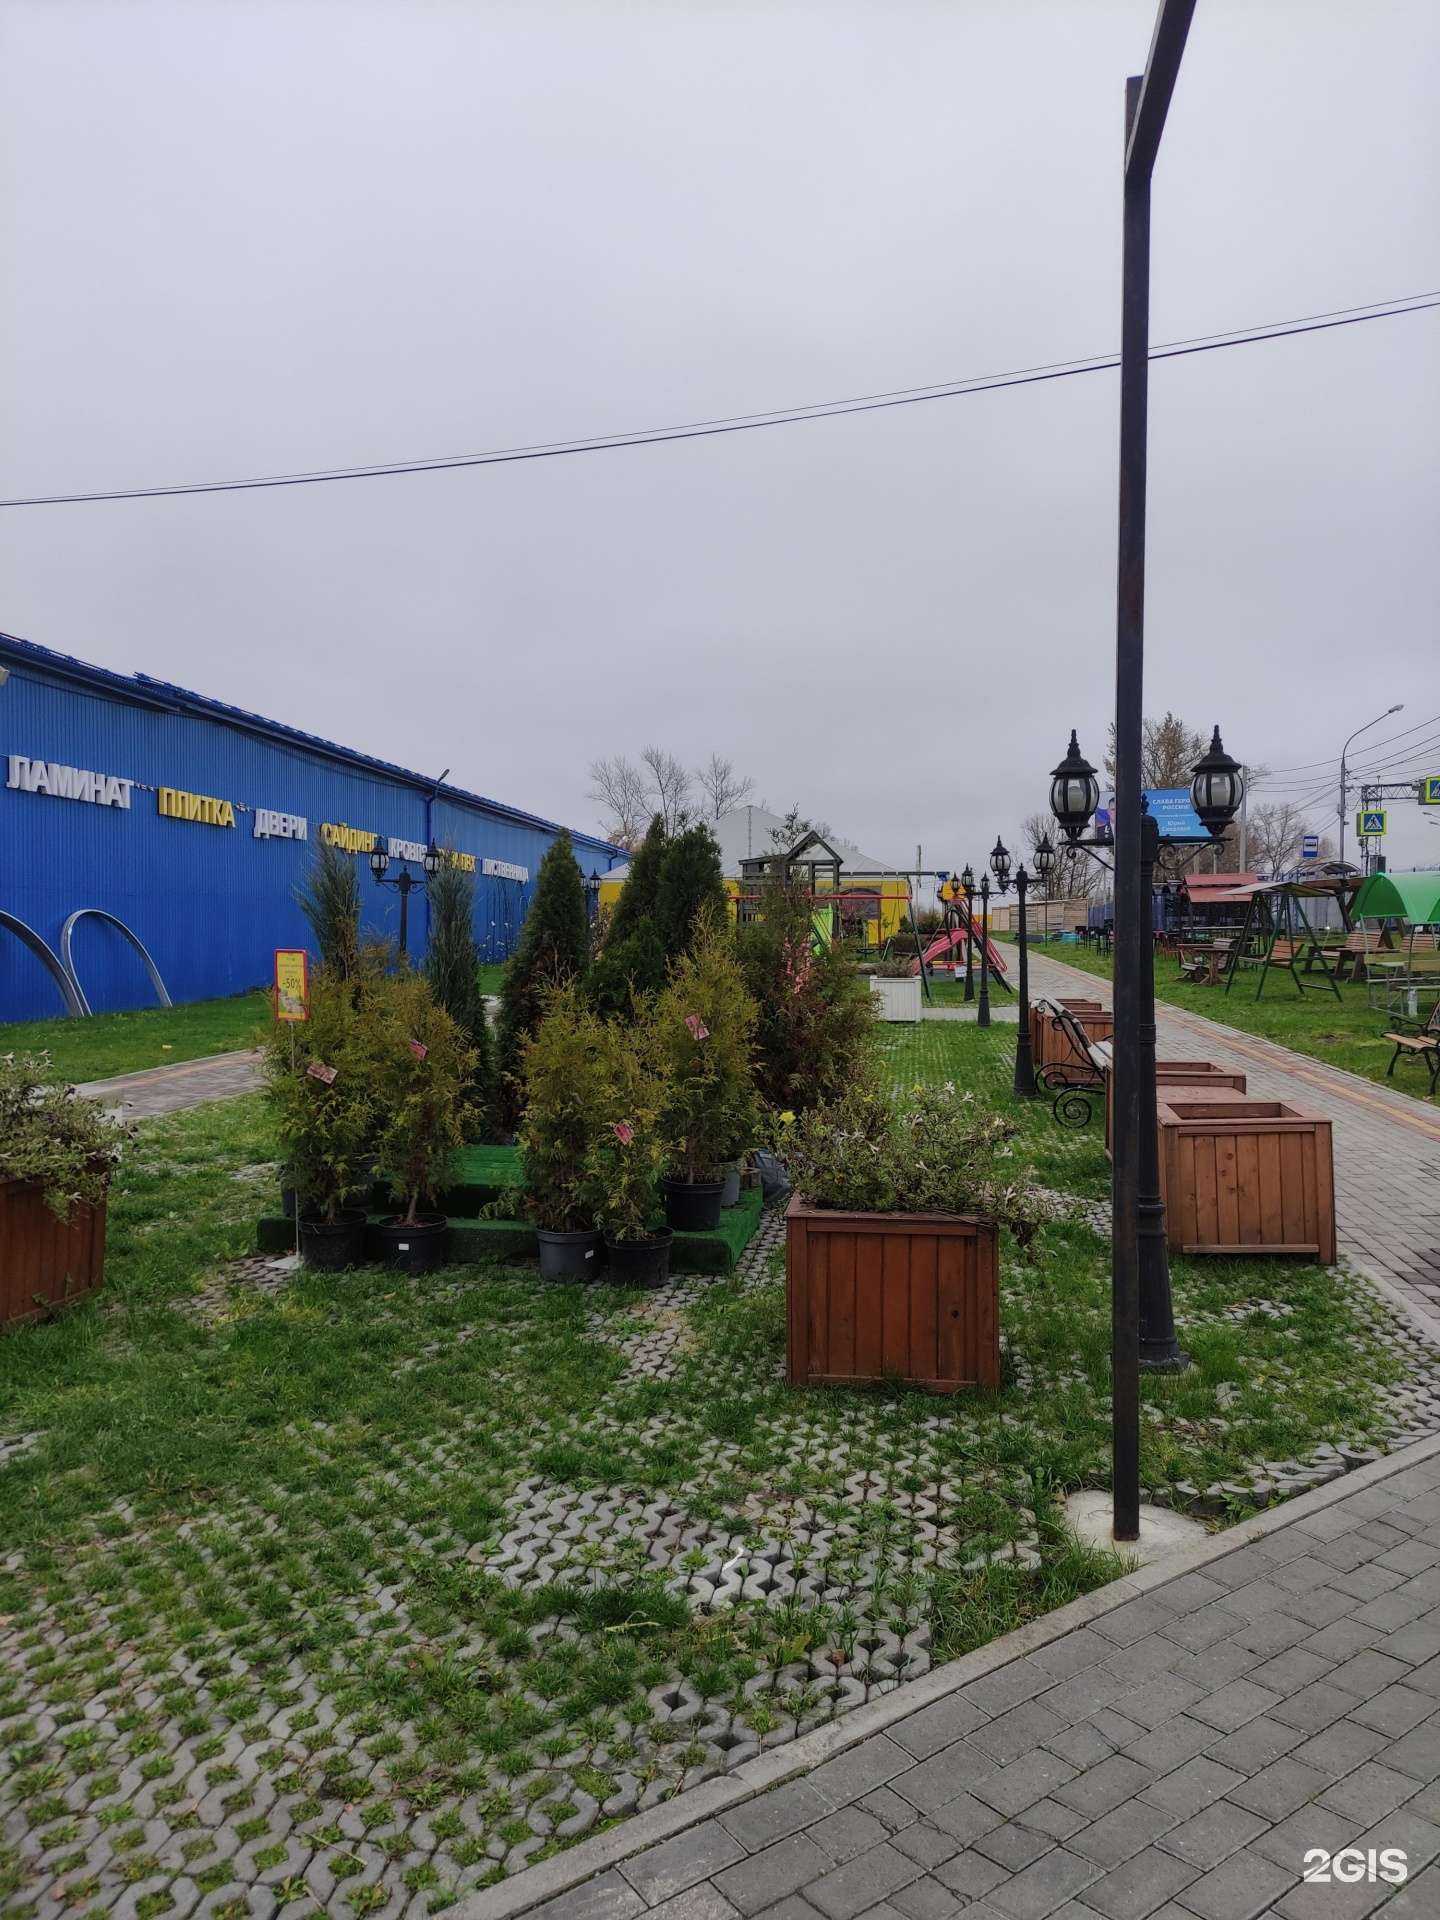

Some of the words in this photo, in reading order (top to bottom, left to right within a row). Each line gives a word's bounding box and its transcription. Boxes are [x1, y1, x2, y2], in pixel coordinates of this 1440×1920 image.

[6, 754, 134, 809] ЛАМИНАТ
[158, 786, 236, 828] ПЛИТКА
[253, 808, 308, 841] ДВЕРИ
[320, 822, 379, 855] САЙДИНГ
